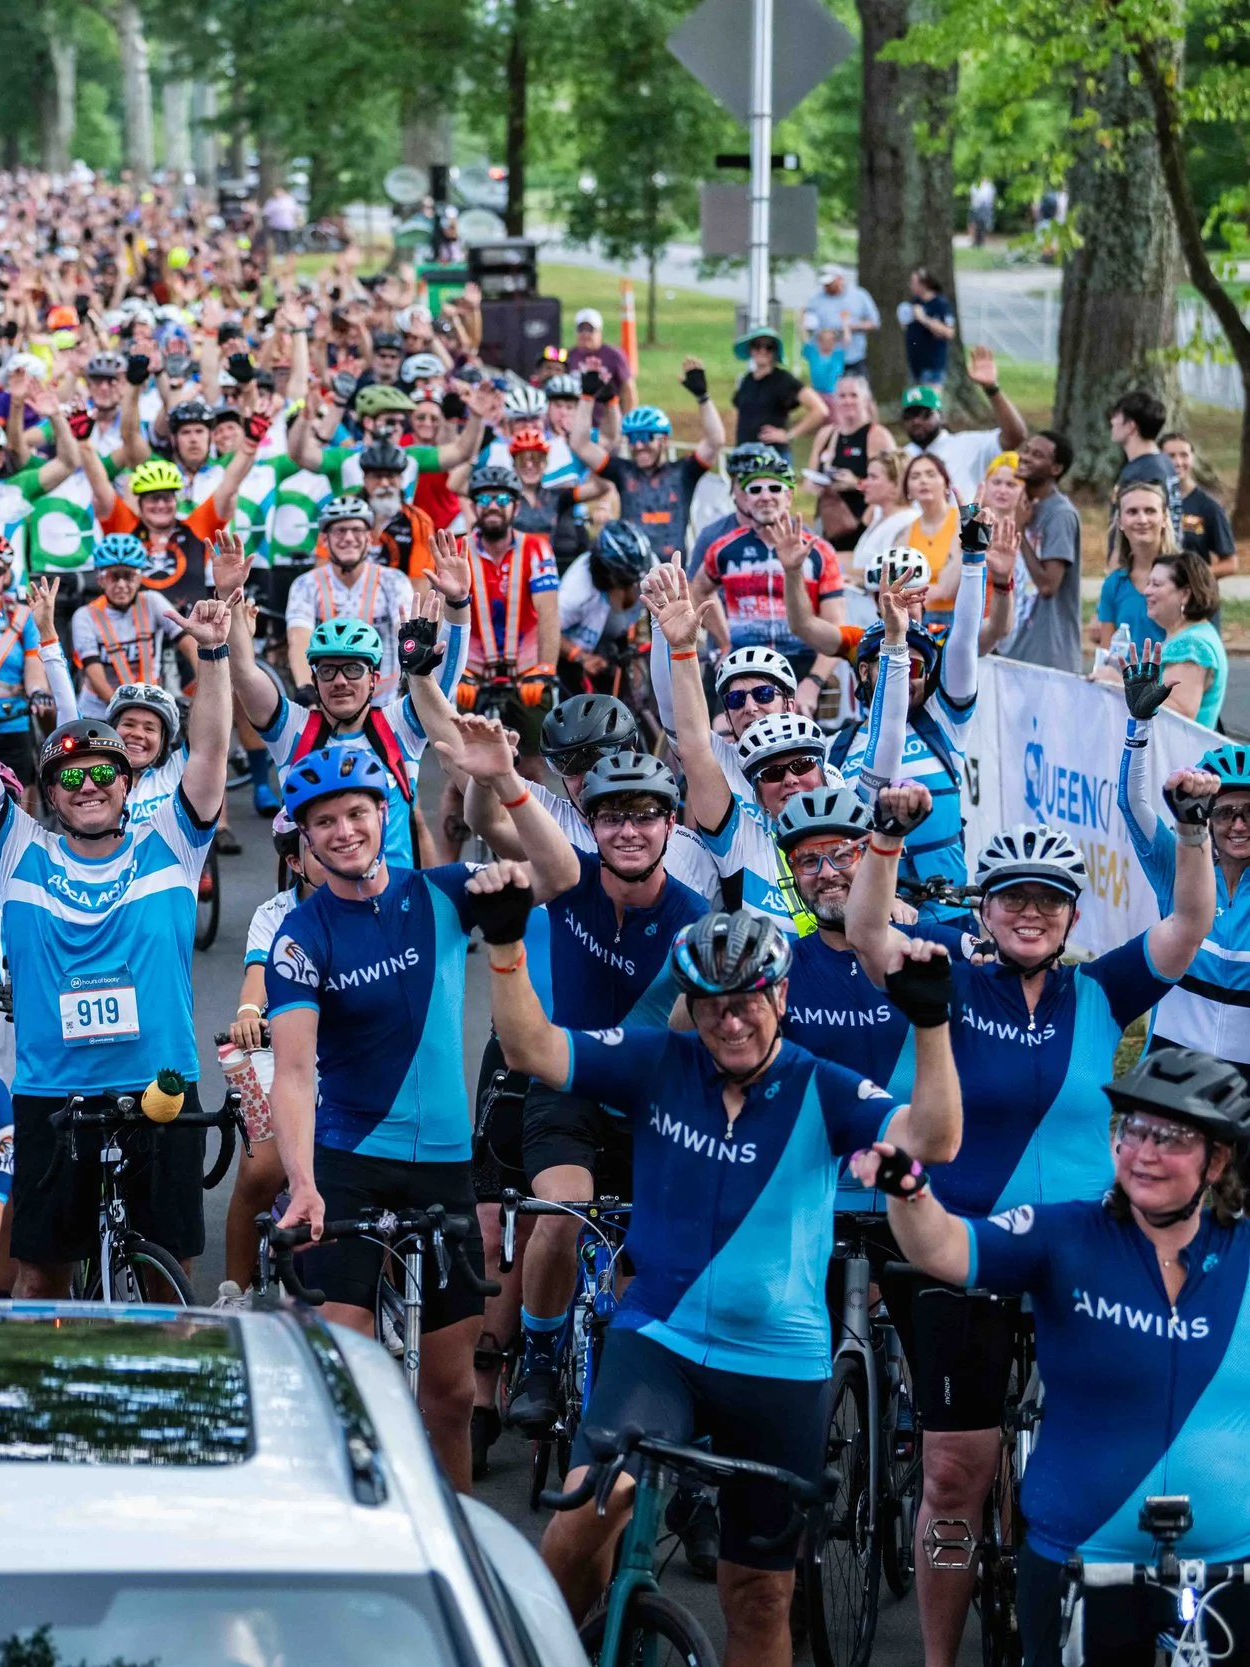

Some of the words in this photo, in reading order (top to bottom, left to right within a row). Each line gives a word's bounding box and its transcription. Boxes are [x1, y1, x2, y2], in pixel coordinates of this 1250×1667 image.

[565, 908, 635, 976] AMWINS
[324, 947, 419, 992] AMWINS
[77, 997, 120, 1027] 919
[787, 1005, 891, 1027] AMWINS
[961, 1004, 1056, 1047] AMWINS
[649, 1103, 757, 1163] AMWINS
[1072, 1288, 1210, 1341] AMWINS
